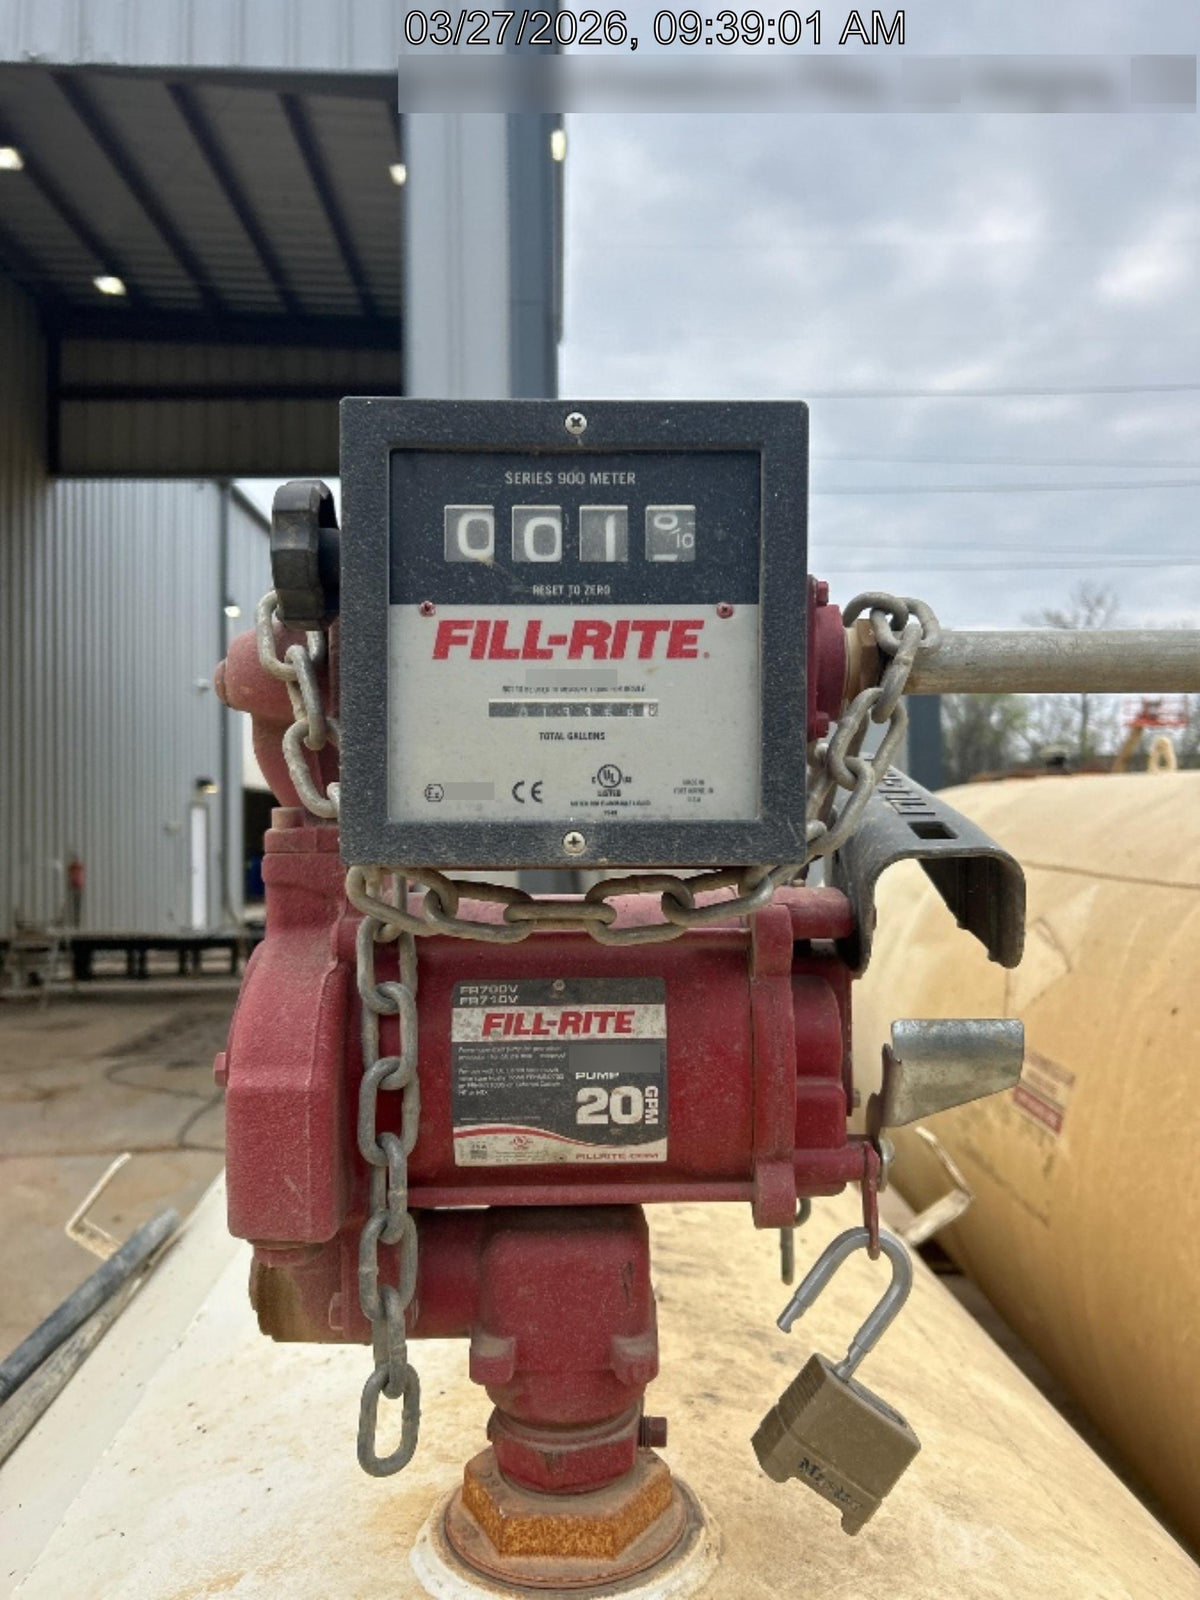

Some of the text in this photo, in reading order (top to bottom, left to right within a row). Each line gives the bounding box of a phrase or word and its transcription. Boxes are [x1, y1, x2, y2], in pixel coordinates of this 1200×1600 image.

[505, 471, 637, 485] SERIES 900 METER
[532, 584, 611, 596] RESET TO ZERO
[431, 619, 706, 660] FILL-RITE
[538, 731, 606, 741] TOTAL GALLONS
[459, 984, 519, 995] FR700V
[482, 1010, 636, 1038] FILL-RITE
[575, 1071, 620, 1080] PUMP
[576, 1085, 644, 1125] 20
[644, 1085, 659, 1125] GPM
